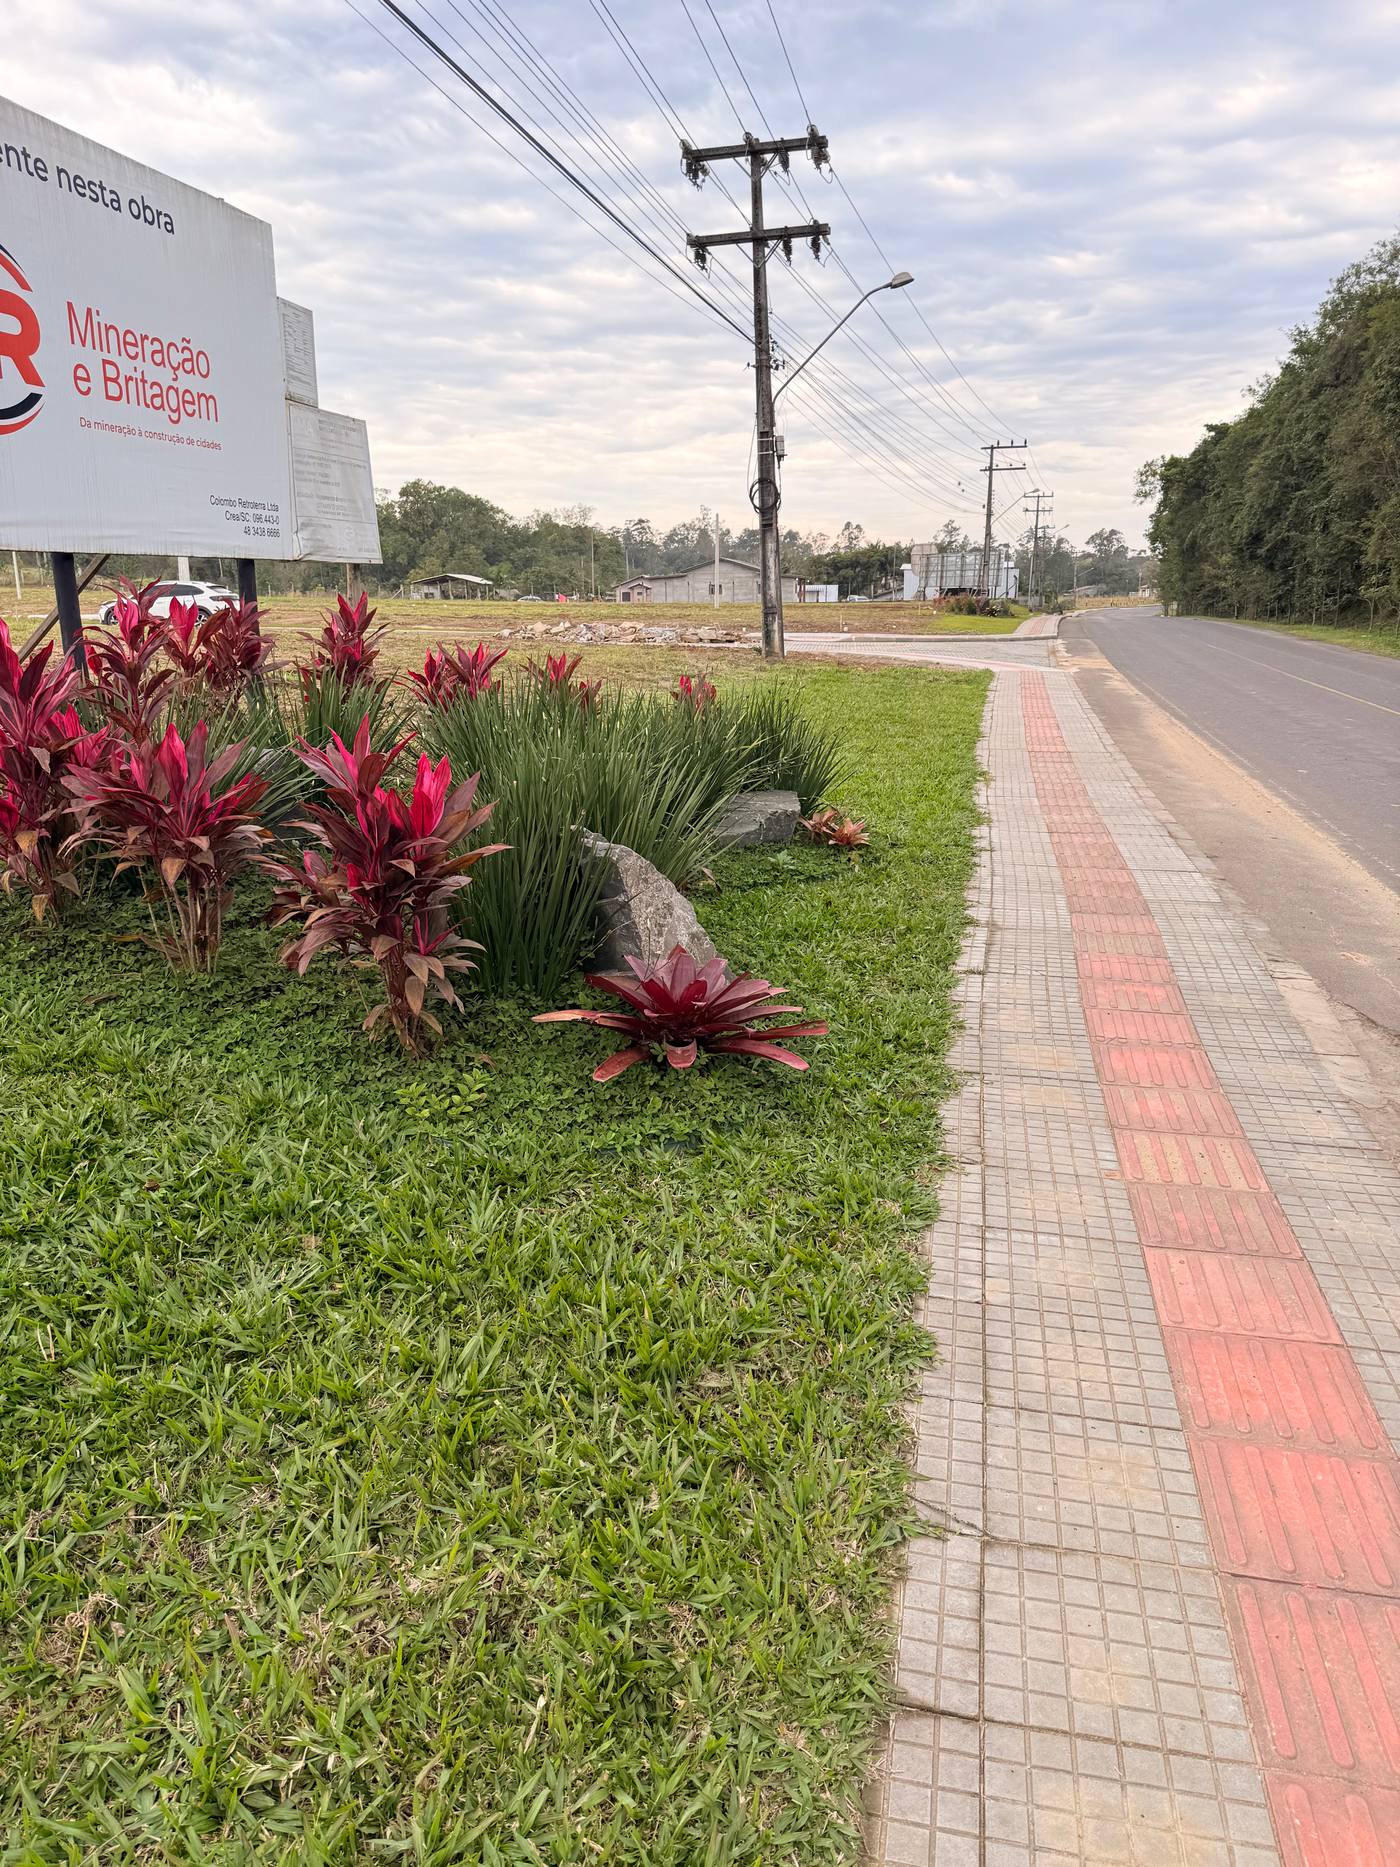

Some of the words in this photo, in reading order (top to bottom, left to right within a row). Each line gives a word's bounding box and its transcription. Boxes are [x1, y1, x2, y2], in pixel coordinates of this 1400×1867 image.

[0, 143, 49, 181] nte
[56, 165, 122, 213] nesta
[128, 195, 175, 235] obra
[66, 300, 210, 381] Mineração
[73, 363, 91, 396] e
[101, 358, 218, 424] Britagem
[79, 416, 92, 429] Da
[94, 420, 137, 437] mineração
[138, 426, 143, 437] à
[144, 430, 185, 446] construção
[186, 436, 195, 446] de
[196, 437, 222, 450] cidades
[210, 494, 238, 508] Colombo
[238, 497, 266, 511] Retroterra
[267, 501, 279, 512] Ltda
